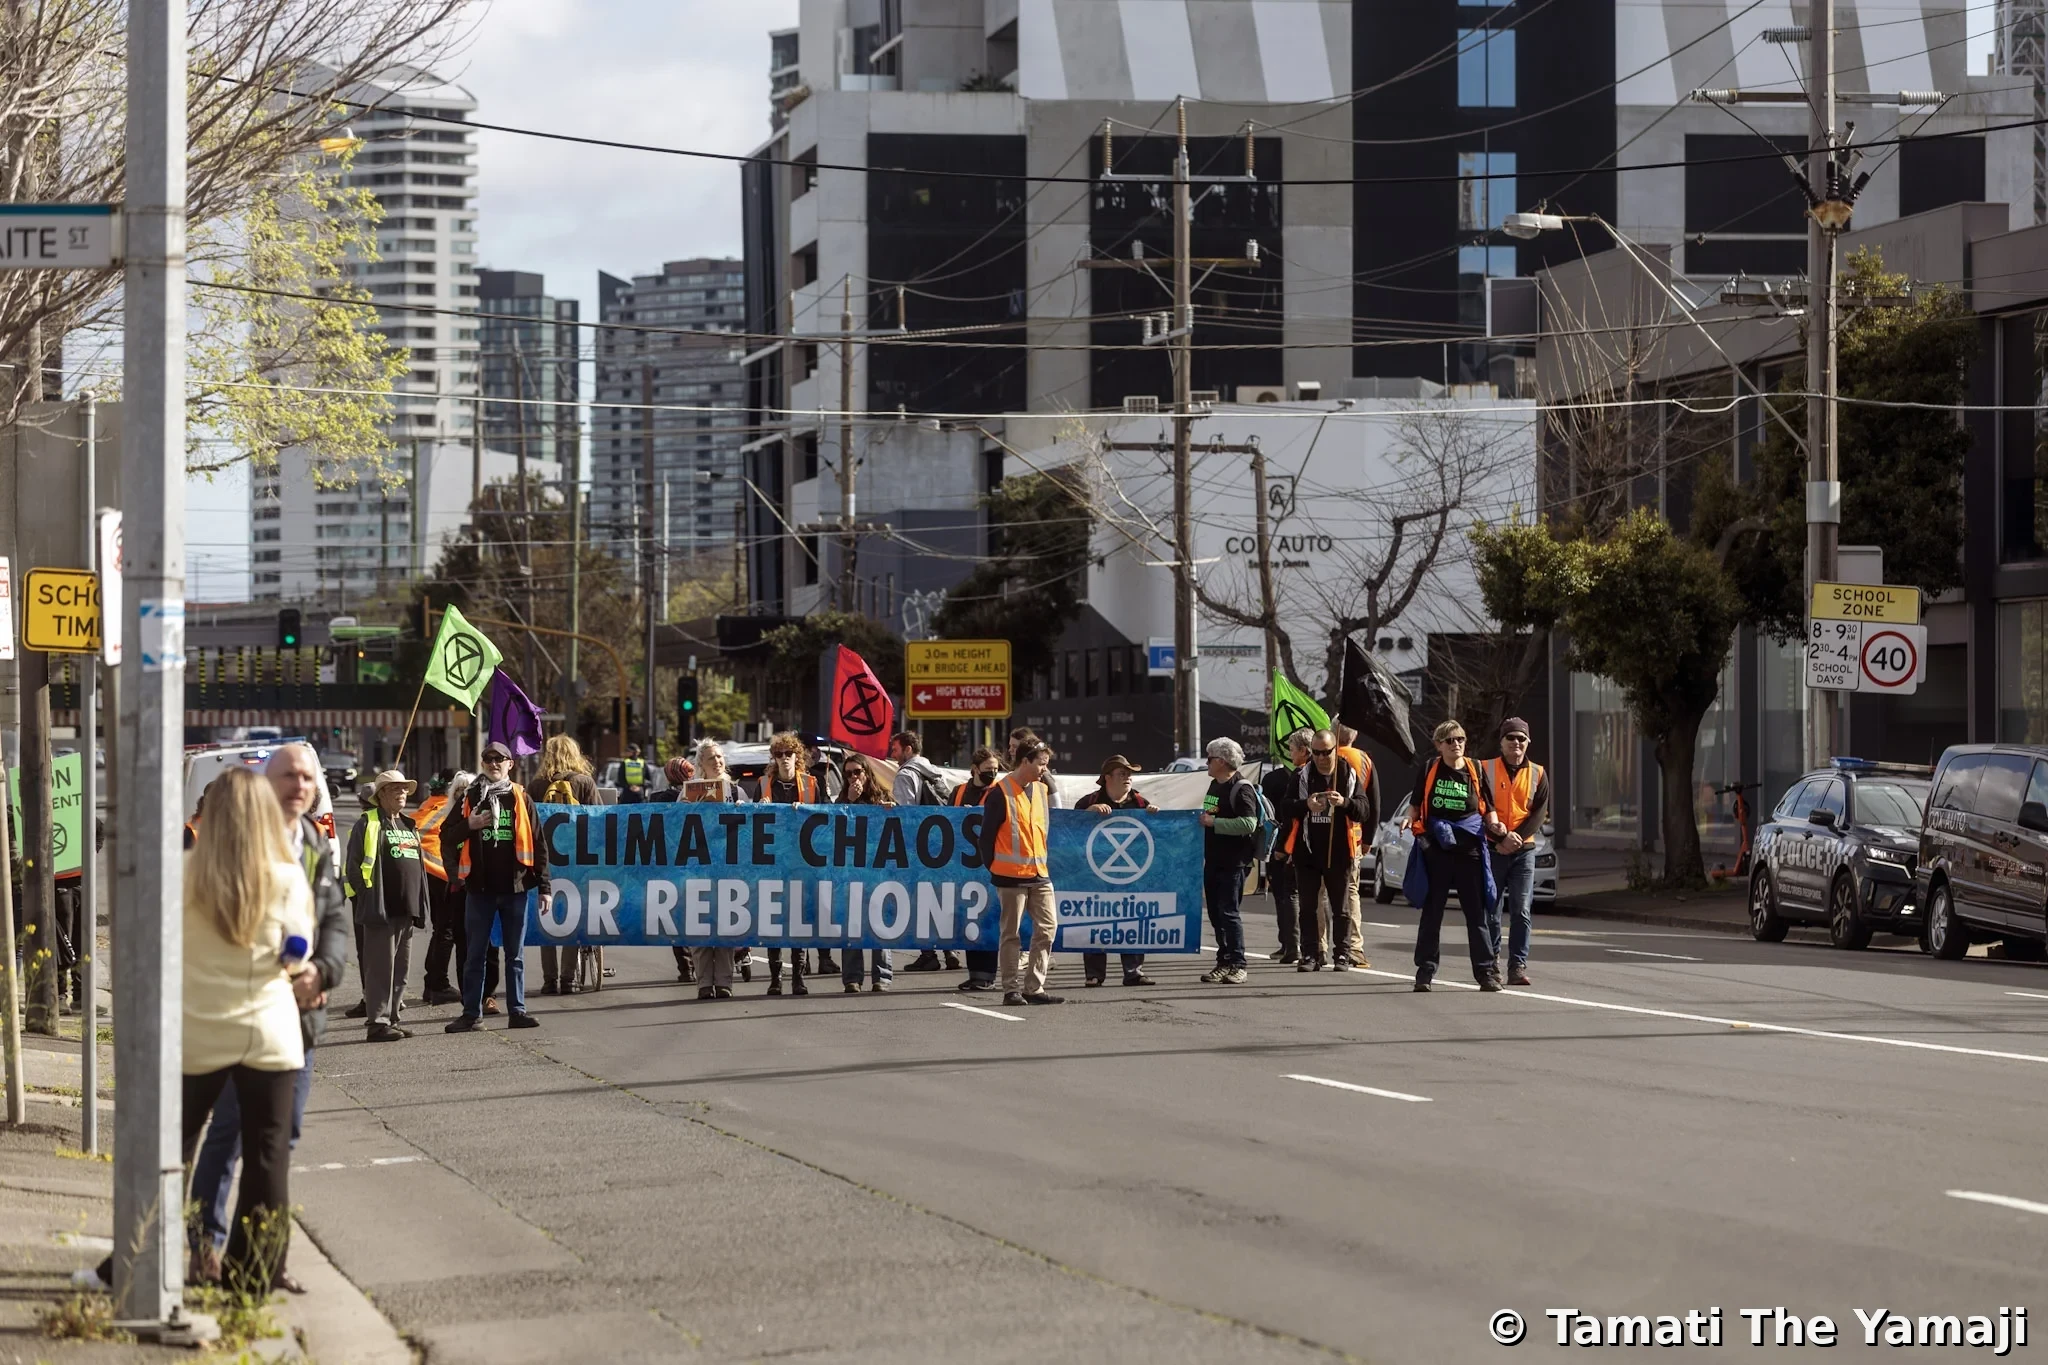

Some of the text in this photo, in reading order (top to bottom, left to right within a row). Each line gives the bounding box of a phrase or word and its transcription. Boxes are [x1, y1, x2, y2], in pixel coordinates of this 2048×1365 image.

[0, 226, 90, 259] ITE ST
[1226, 535, 1332, 554] CO AUTO
[1833, 588, 1895, 603] SCHOOL
[1842, 603, 1884, 616] ZONE
[953, 649, 992, 659] HEIGHT
[1870, 646, 1907, 671] 40
[911, 663, 1006, 673] LOW BRIDGE AHEAD
[1812, 663, 1852, 674] SCHOOL
[1816, 675, 1844, 685] DAYS
[936, 686, 1001, 696] HIGH VEHICLES
[951, 699, 986, 709] DETOUR
[546, 813, 983, 869] CLIMATE CHAOS
[1779, 840, 1824, 870] POLICE
[538, 878, 988, 942] OR REBELLION?
[1060, 895, 1160, 918] extinction
[1090, 920, 1180, 945] rebellion
